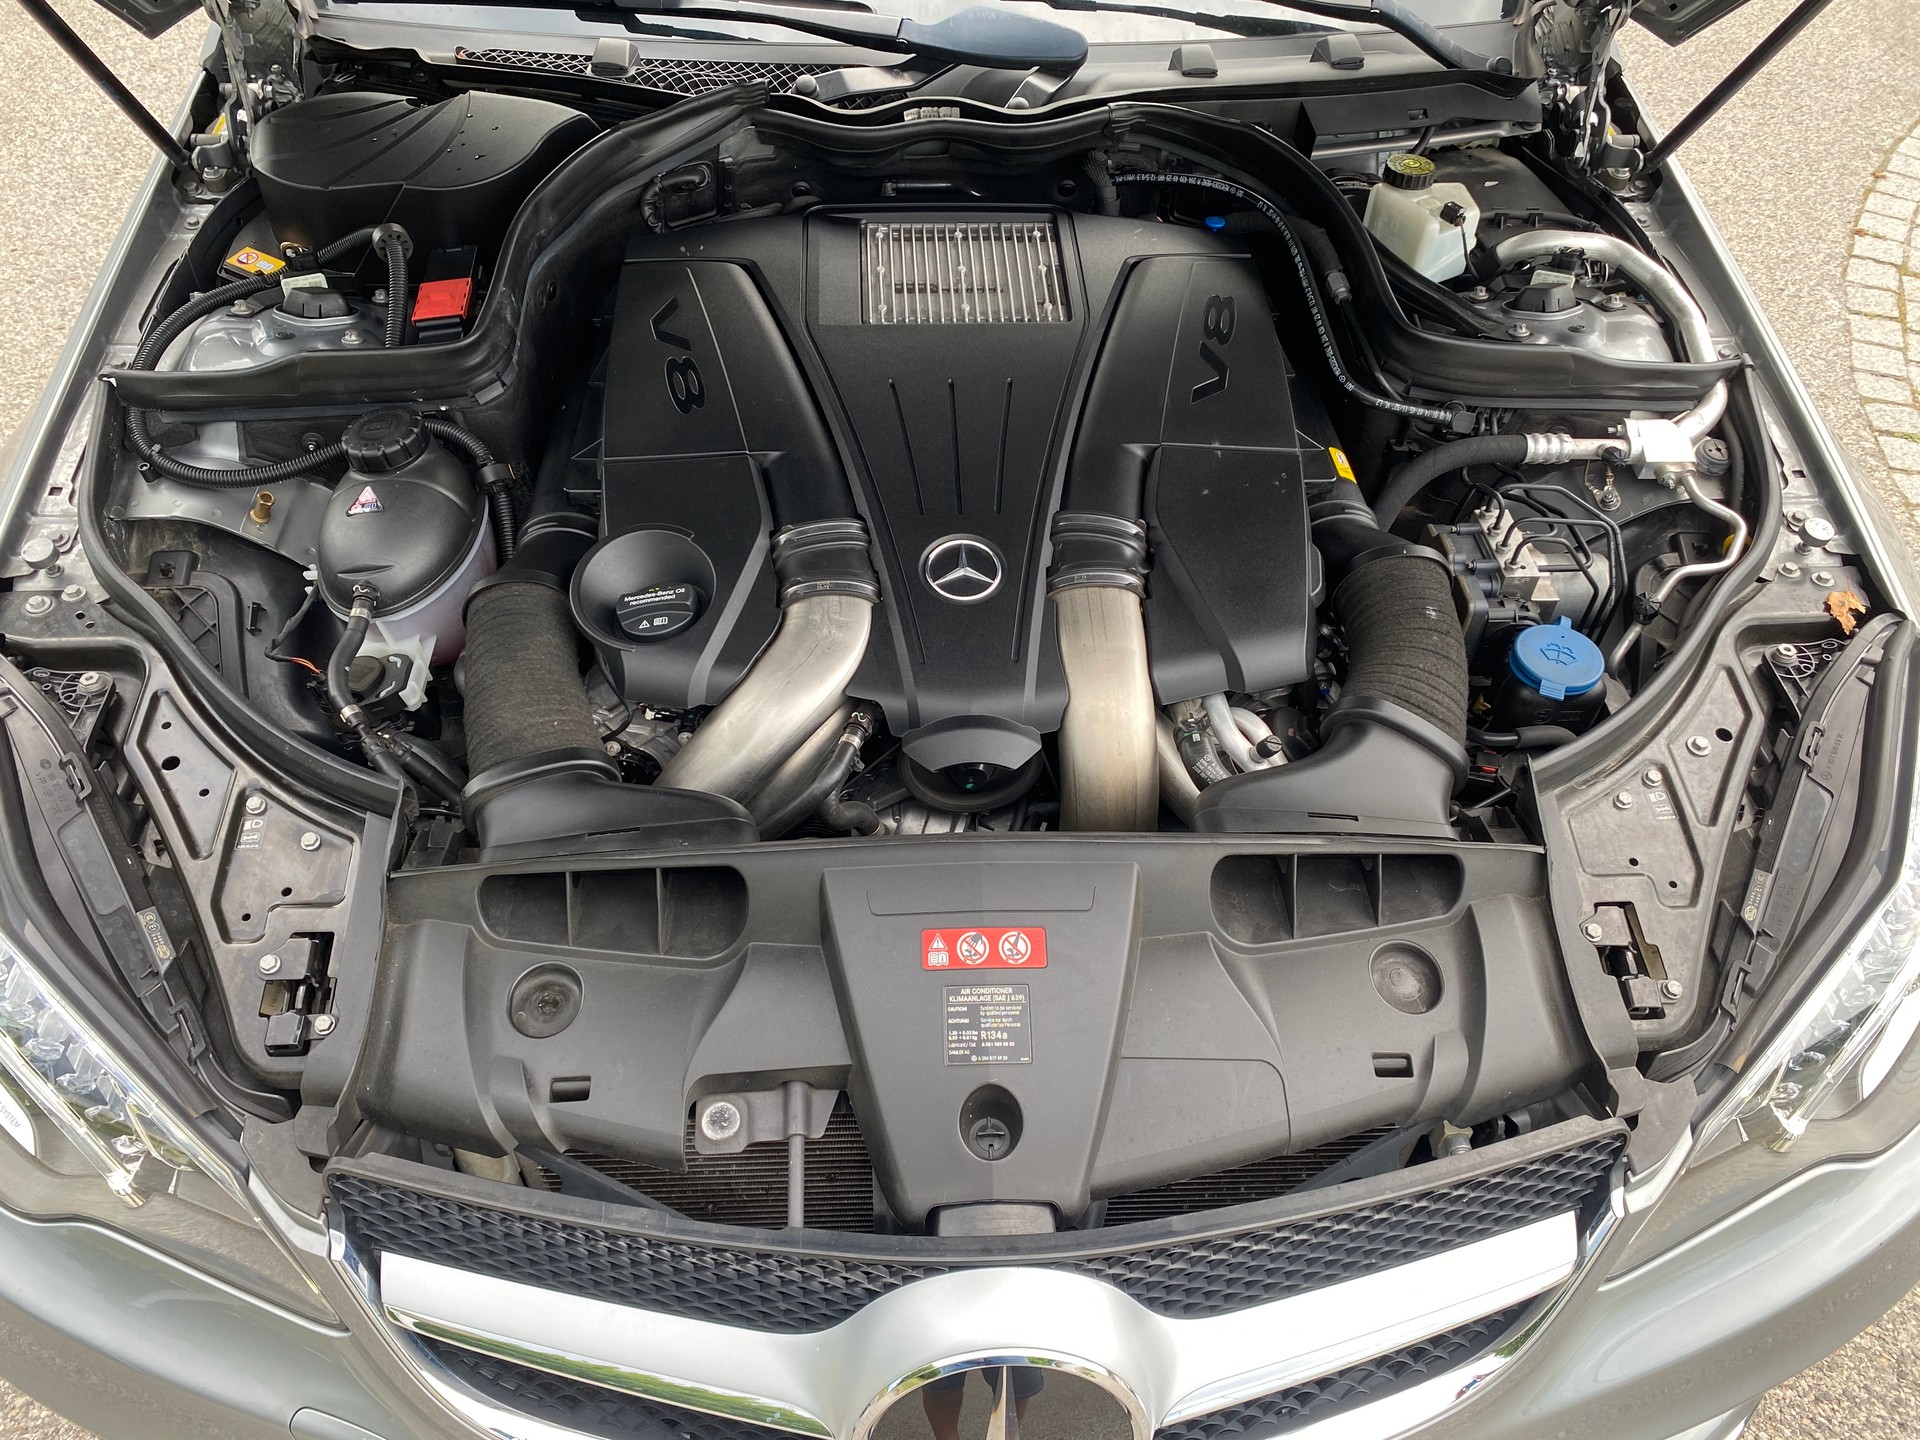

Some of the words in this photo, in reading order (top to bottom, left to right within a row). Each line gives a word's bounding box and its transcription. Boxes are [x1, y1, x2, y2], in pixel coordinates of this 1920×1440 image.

[650, 296, 706, 415] V8
[1190, 294, 1237, 404] V8
[624, 590, 674, 602] Mercedes-Benz
[630, 594, 676, 606] recommended
[981, 1031, 1008, 1040] R134a
[0, 1105, 21, 1128] SYSTEM
